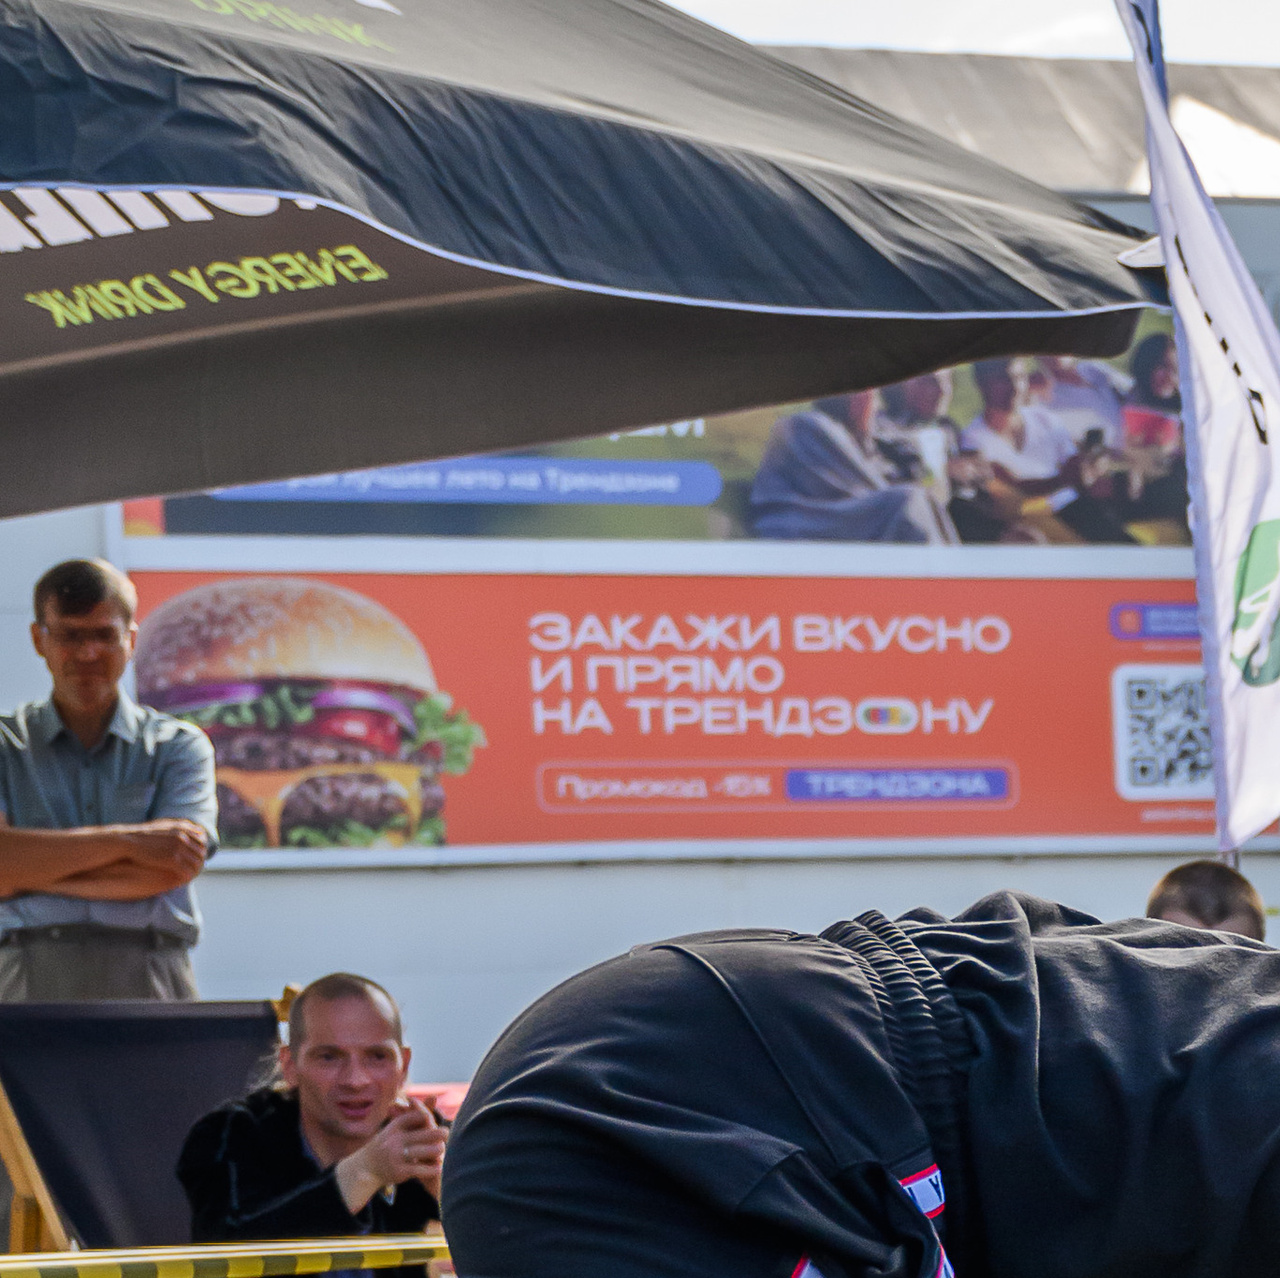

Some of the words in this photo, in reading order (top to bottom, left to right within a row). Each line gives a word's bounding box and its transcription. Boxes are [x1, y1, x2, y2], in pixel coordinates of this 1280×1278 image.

[528, 612, 781, 652] ЗАКАЖИ
[793, 615, 1012, 653] ВКУСНО
[530, 656, 573, 694] И
[586, 656, 785, 694] ПРЯМО
[532, 699, 613, 736] НА
[626, 699, 994, 739] ТРЕНДЗОНУ
